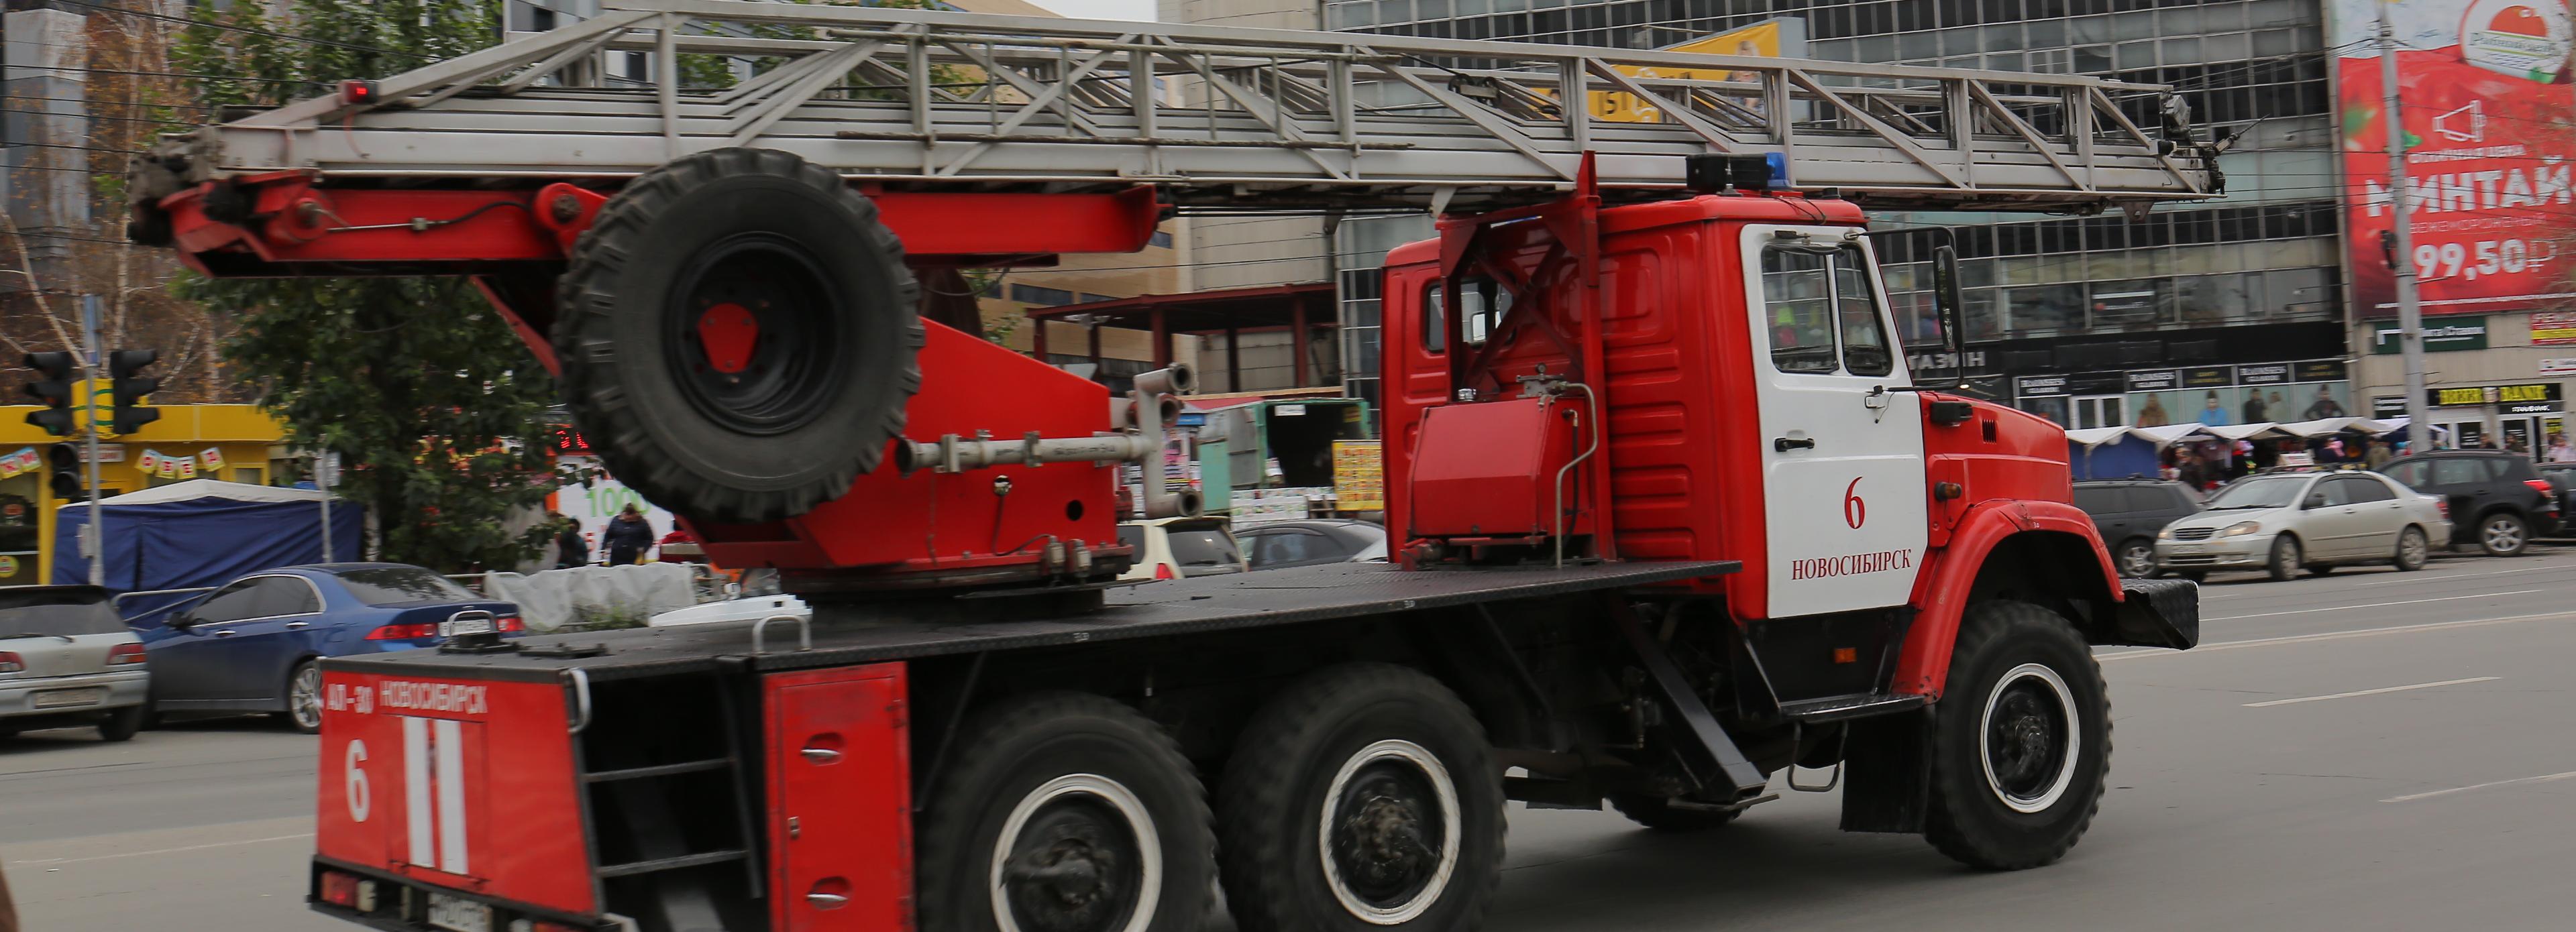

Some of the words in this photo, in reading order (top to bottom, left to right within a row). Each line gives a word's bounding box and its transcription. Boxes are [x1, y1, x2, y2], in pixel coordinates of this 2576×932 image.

[2365, 155, 2572, 217] МИНТАЙ
[1845, 477, 1866, 530] 6
[1792, 548, 1911, 581] НОВОСИБИРСК
[379, 681, 488, 713] НОВОСИБИРСК
[345, 739, 370, 823] 6
